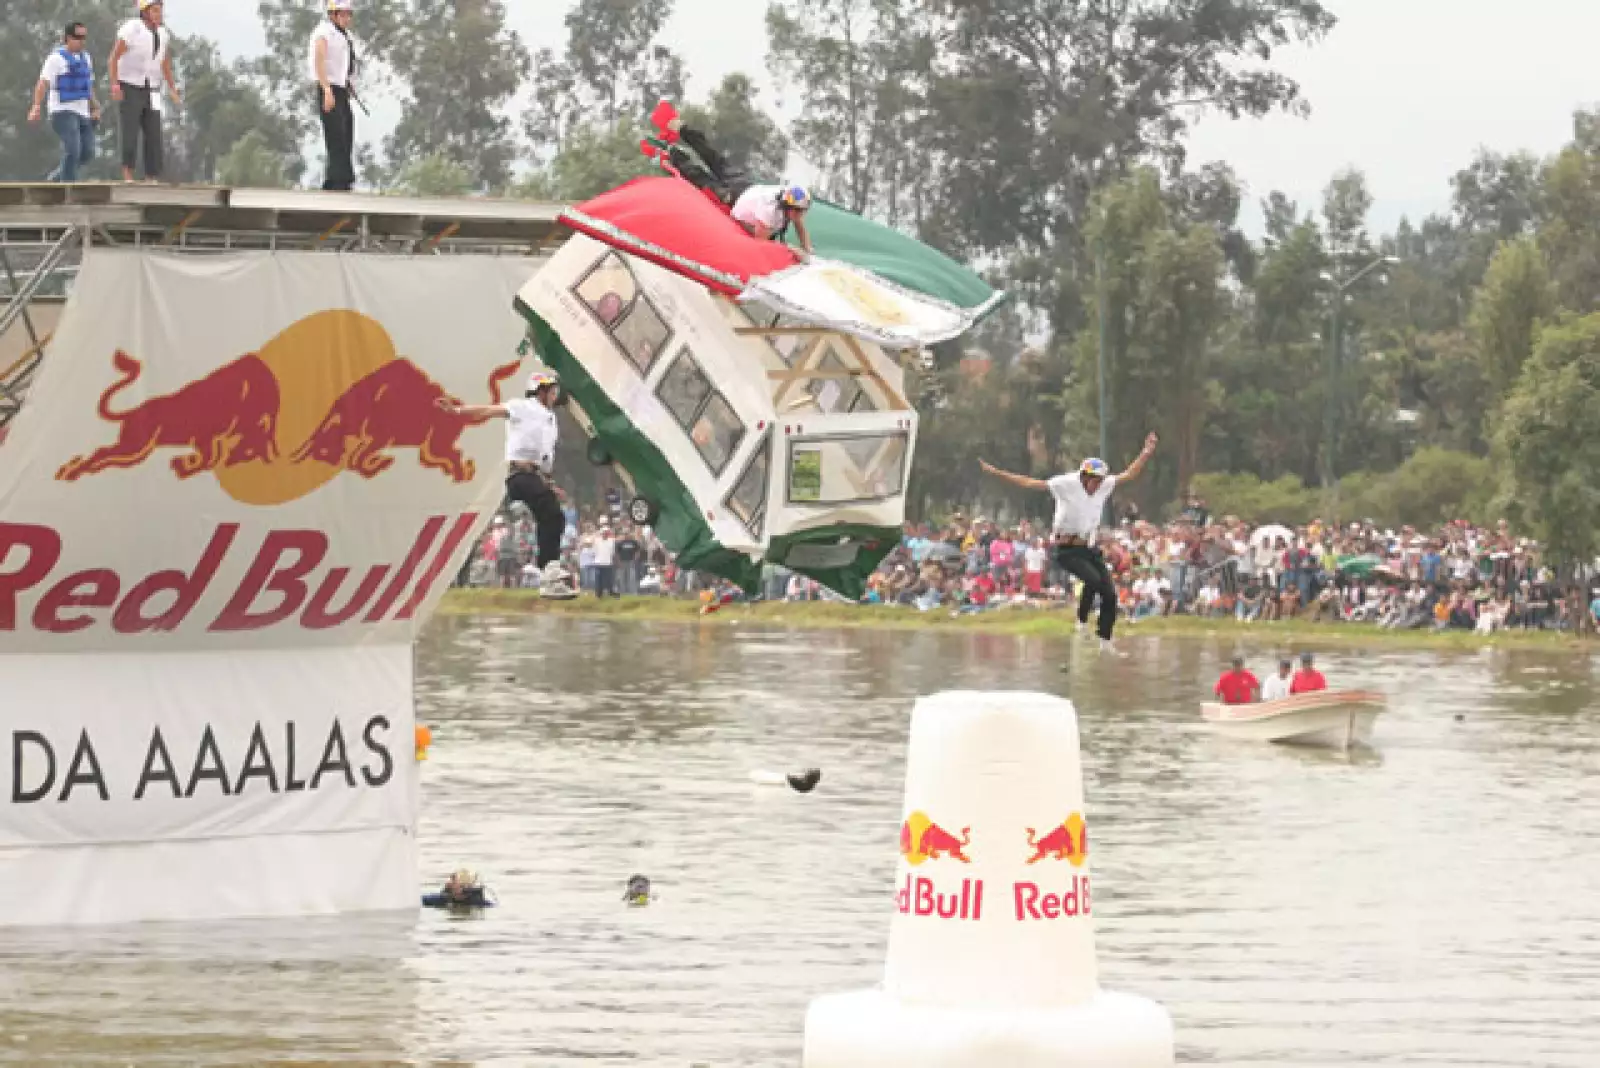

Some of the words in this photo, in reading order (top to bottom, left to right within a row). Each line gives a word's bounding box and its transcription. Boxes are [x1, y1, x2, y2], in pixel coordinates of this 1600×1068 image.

[0, 522, 240, 633] Red
[206, 513, 479, 632] Bull
[12, 727, 110, 803] DA
[134, 714, 394, 800] AAALAS
